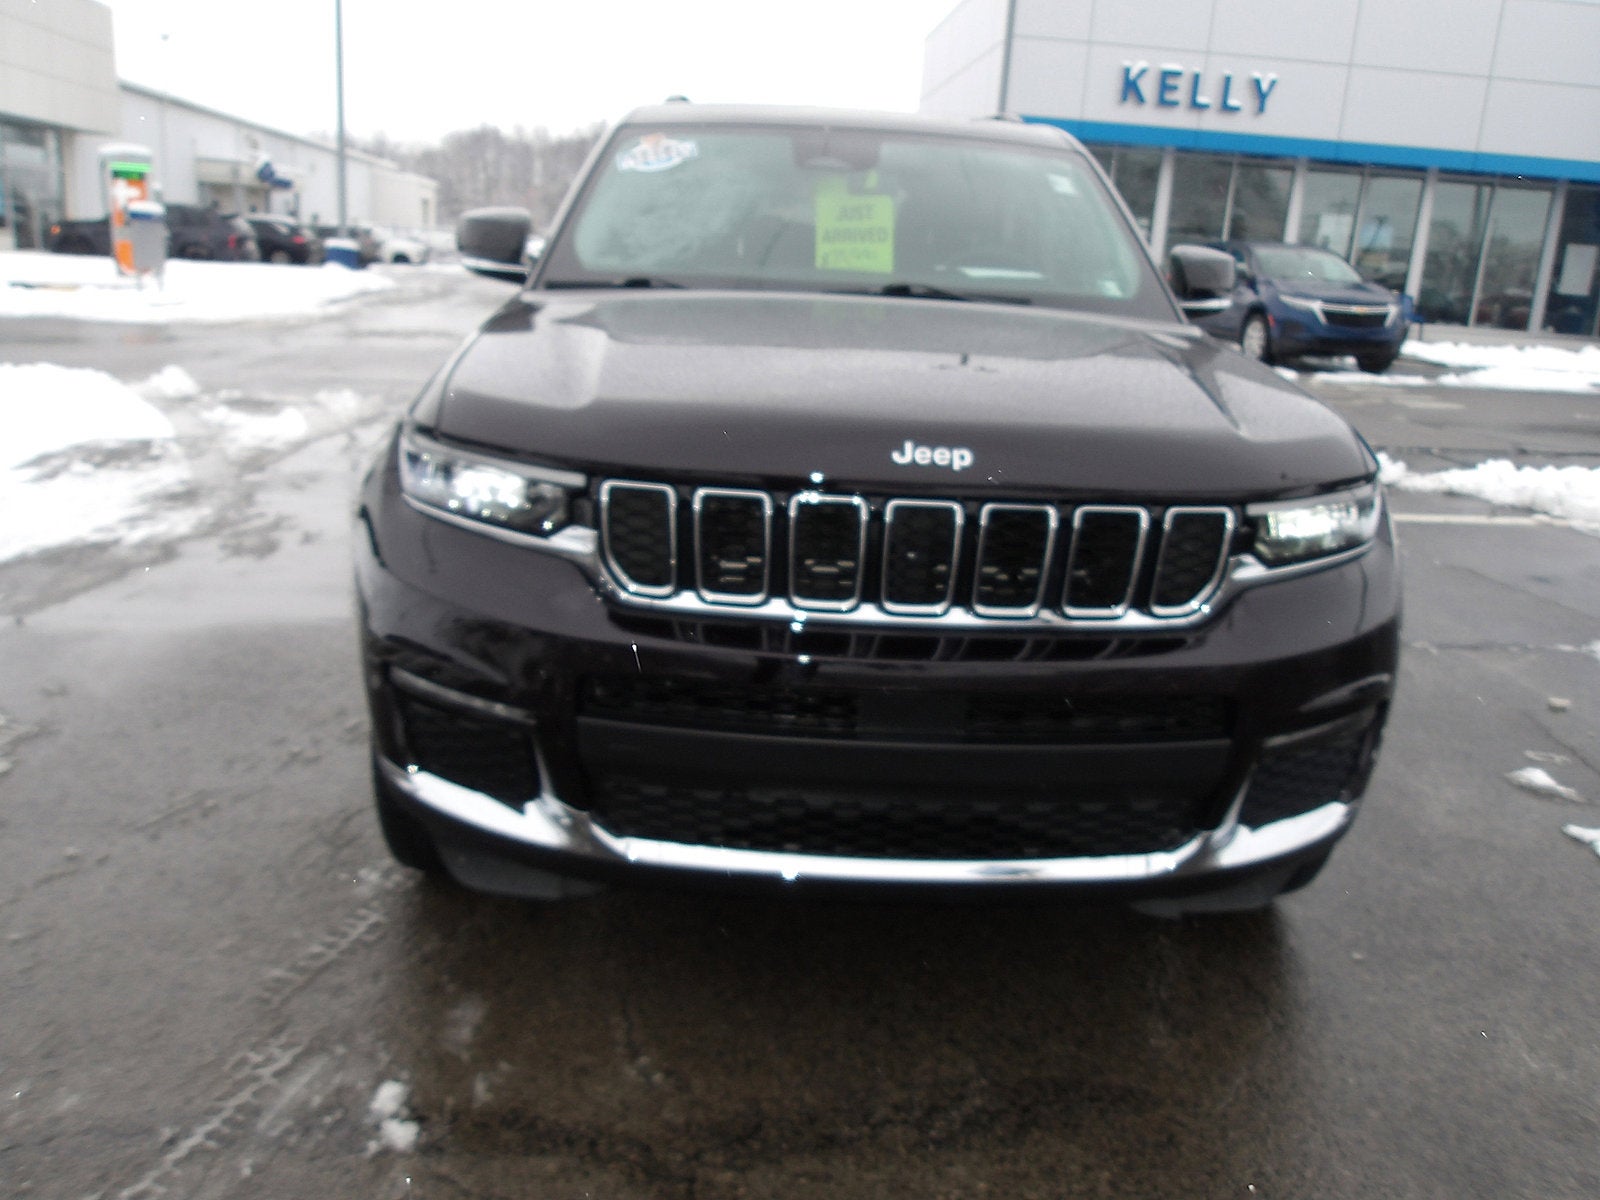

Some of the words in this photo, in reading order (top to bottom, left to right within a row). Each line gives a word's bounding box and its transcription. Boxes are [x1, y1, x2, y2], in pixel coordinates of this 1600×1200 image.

[1121, 61, 1277, 114] KELLY
[821, 226, 889, 244] ARRIVED
[891, 440, 974, 471] Jeep
